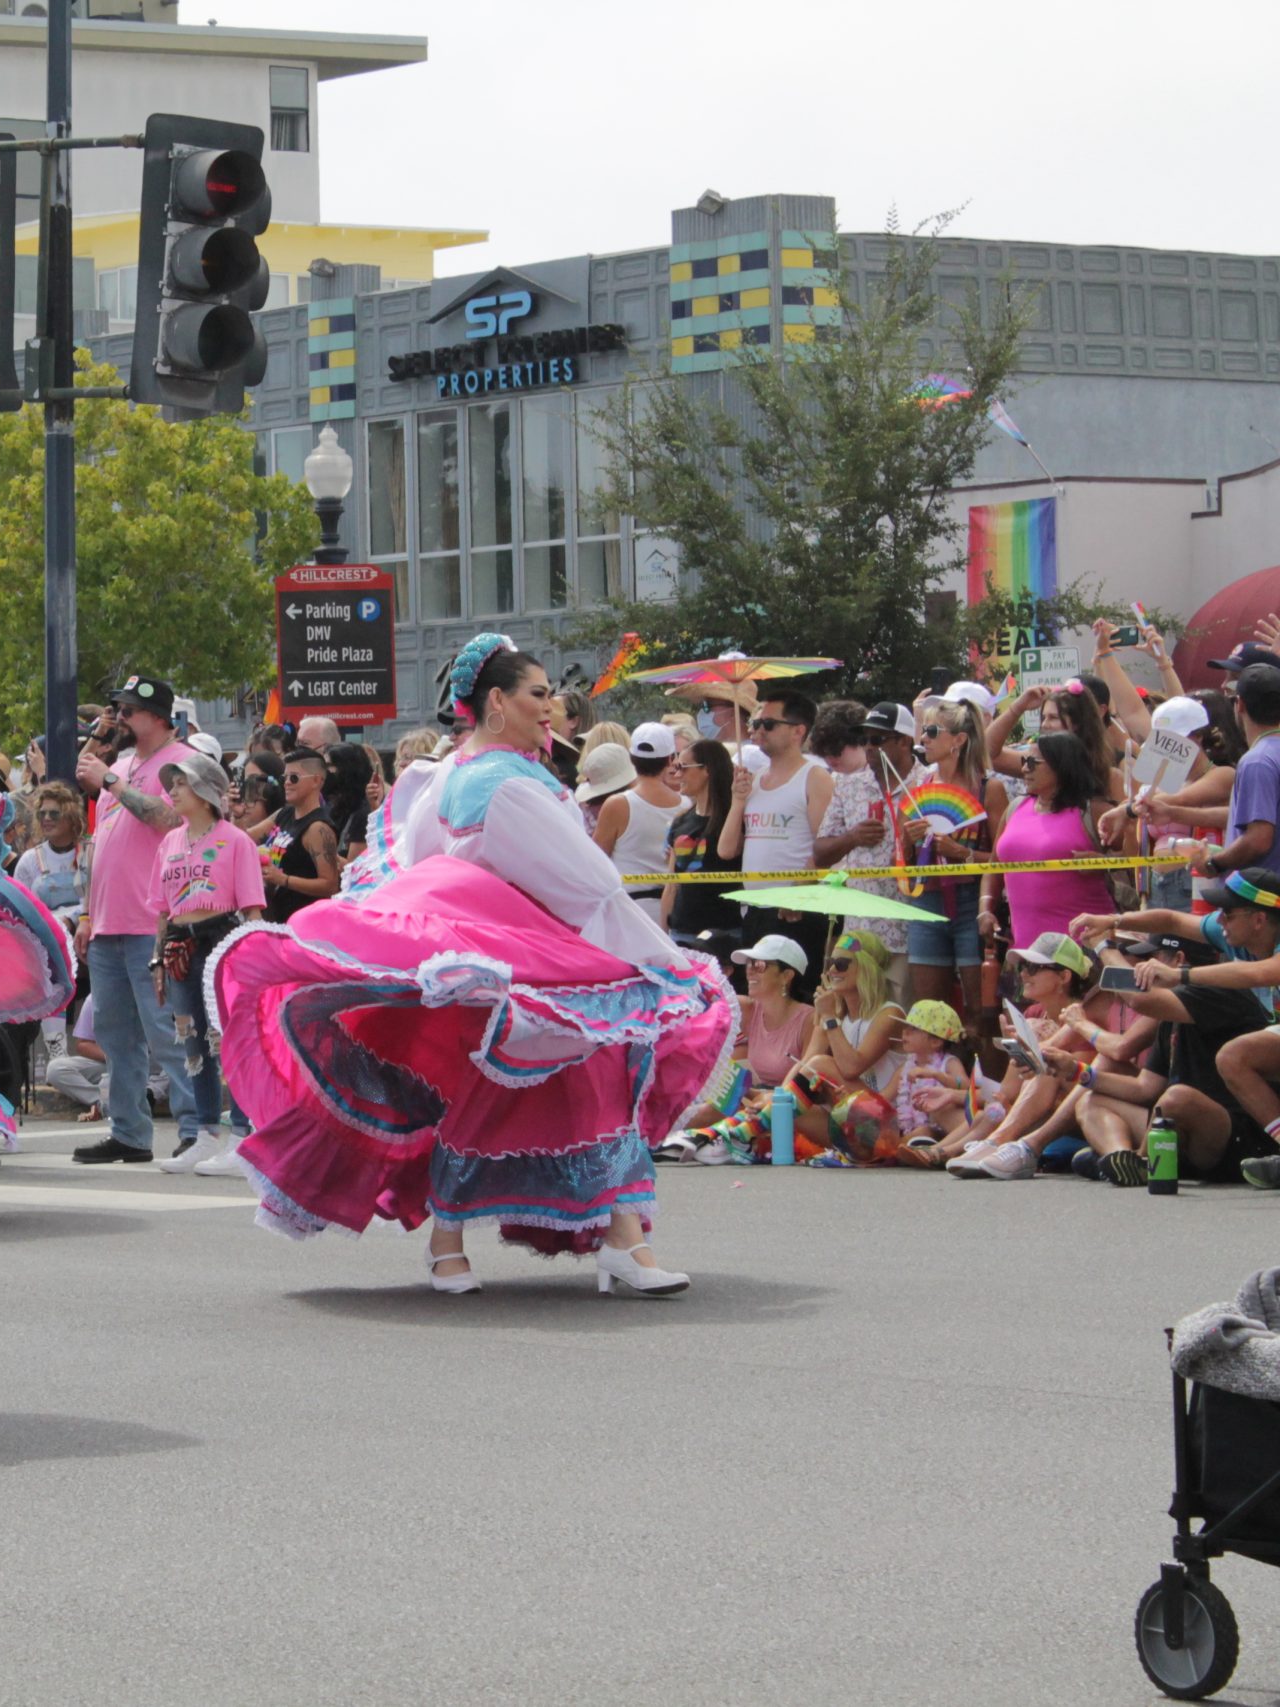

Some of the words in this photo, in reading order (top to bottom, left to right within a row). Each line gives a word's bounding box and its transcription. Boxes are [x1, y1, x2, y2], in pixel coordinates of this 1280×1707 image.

[464, 290, 532, 339] SP
[436, 357, 574, 396] PROPERTIES
[300, 569, 368, 581] HILLCREST
[306, 602, 351, 622] Parking
[362, 601, 376, 619] P
[306, 626, 332, 641] DMV
[307, 647, 338, 663] Pride
[342, 647, 373, 662] Plaza
[1025, 653, 1037, 670] P
[1044, 661, 1076, 670] PARKING
[308, 681, 335, 696] LGBT
[338, 680, 378, 696] Center
[1154, 730, 1192, 758] VIEJAS
[744, 813, 795, 828] TRULY
[162, 865, 211, 883] JUSTICE
